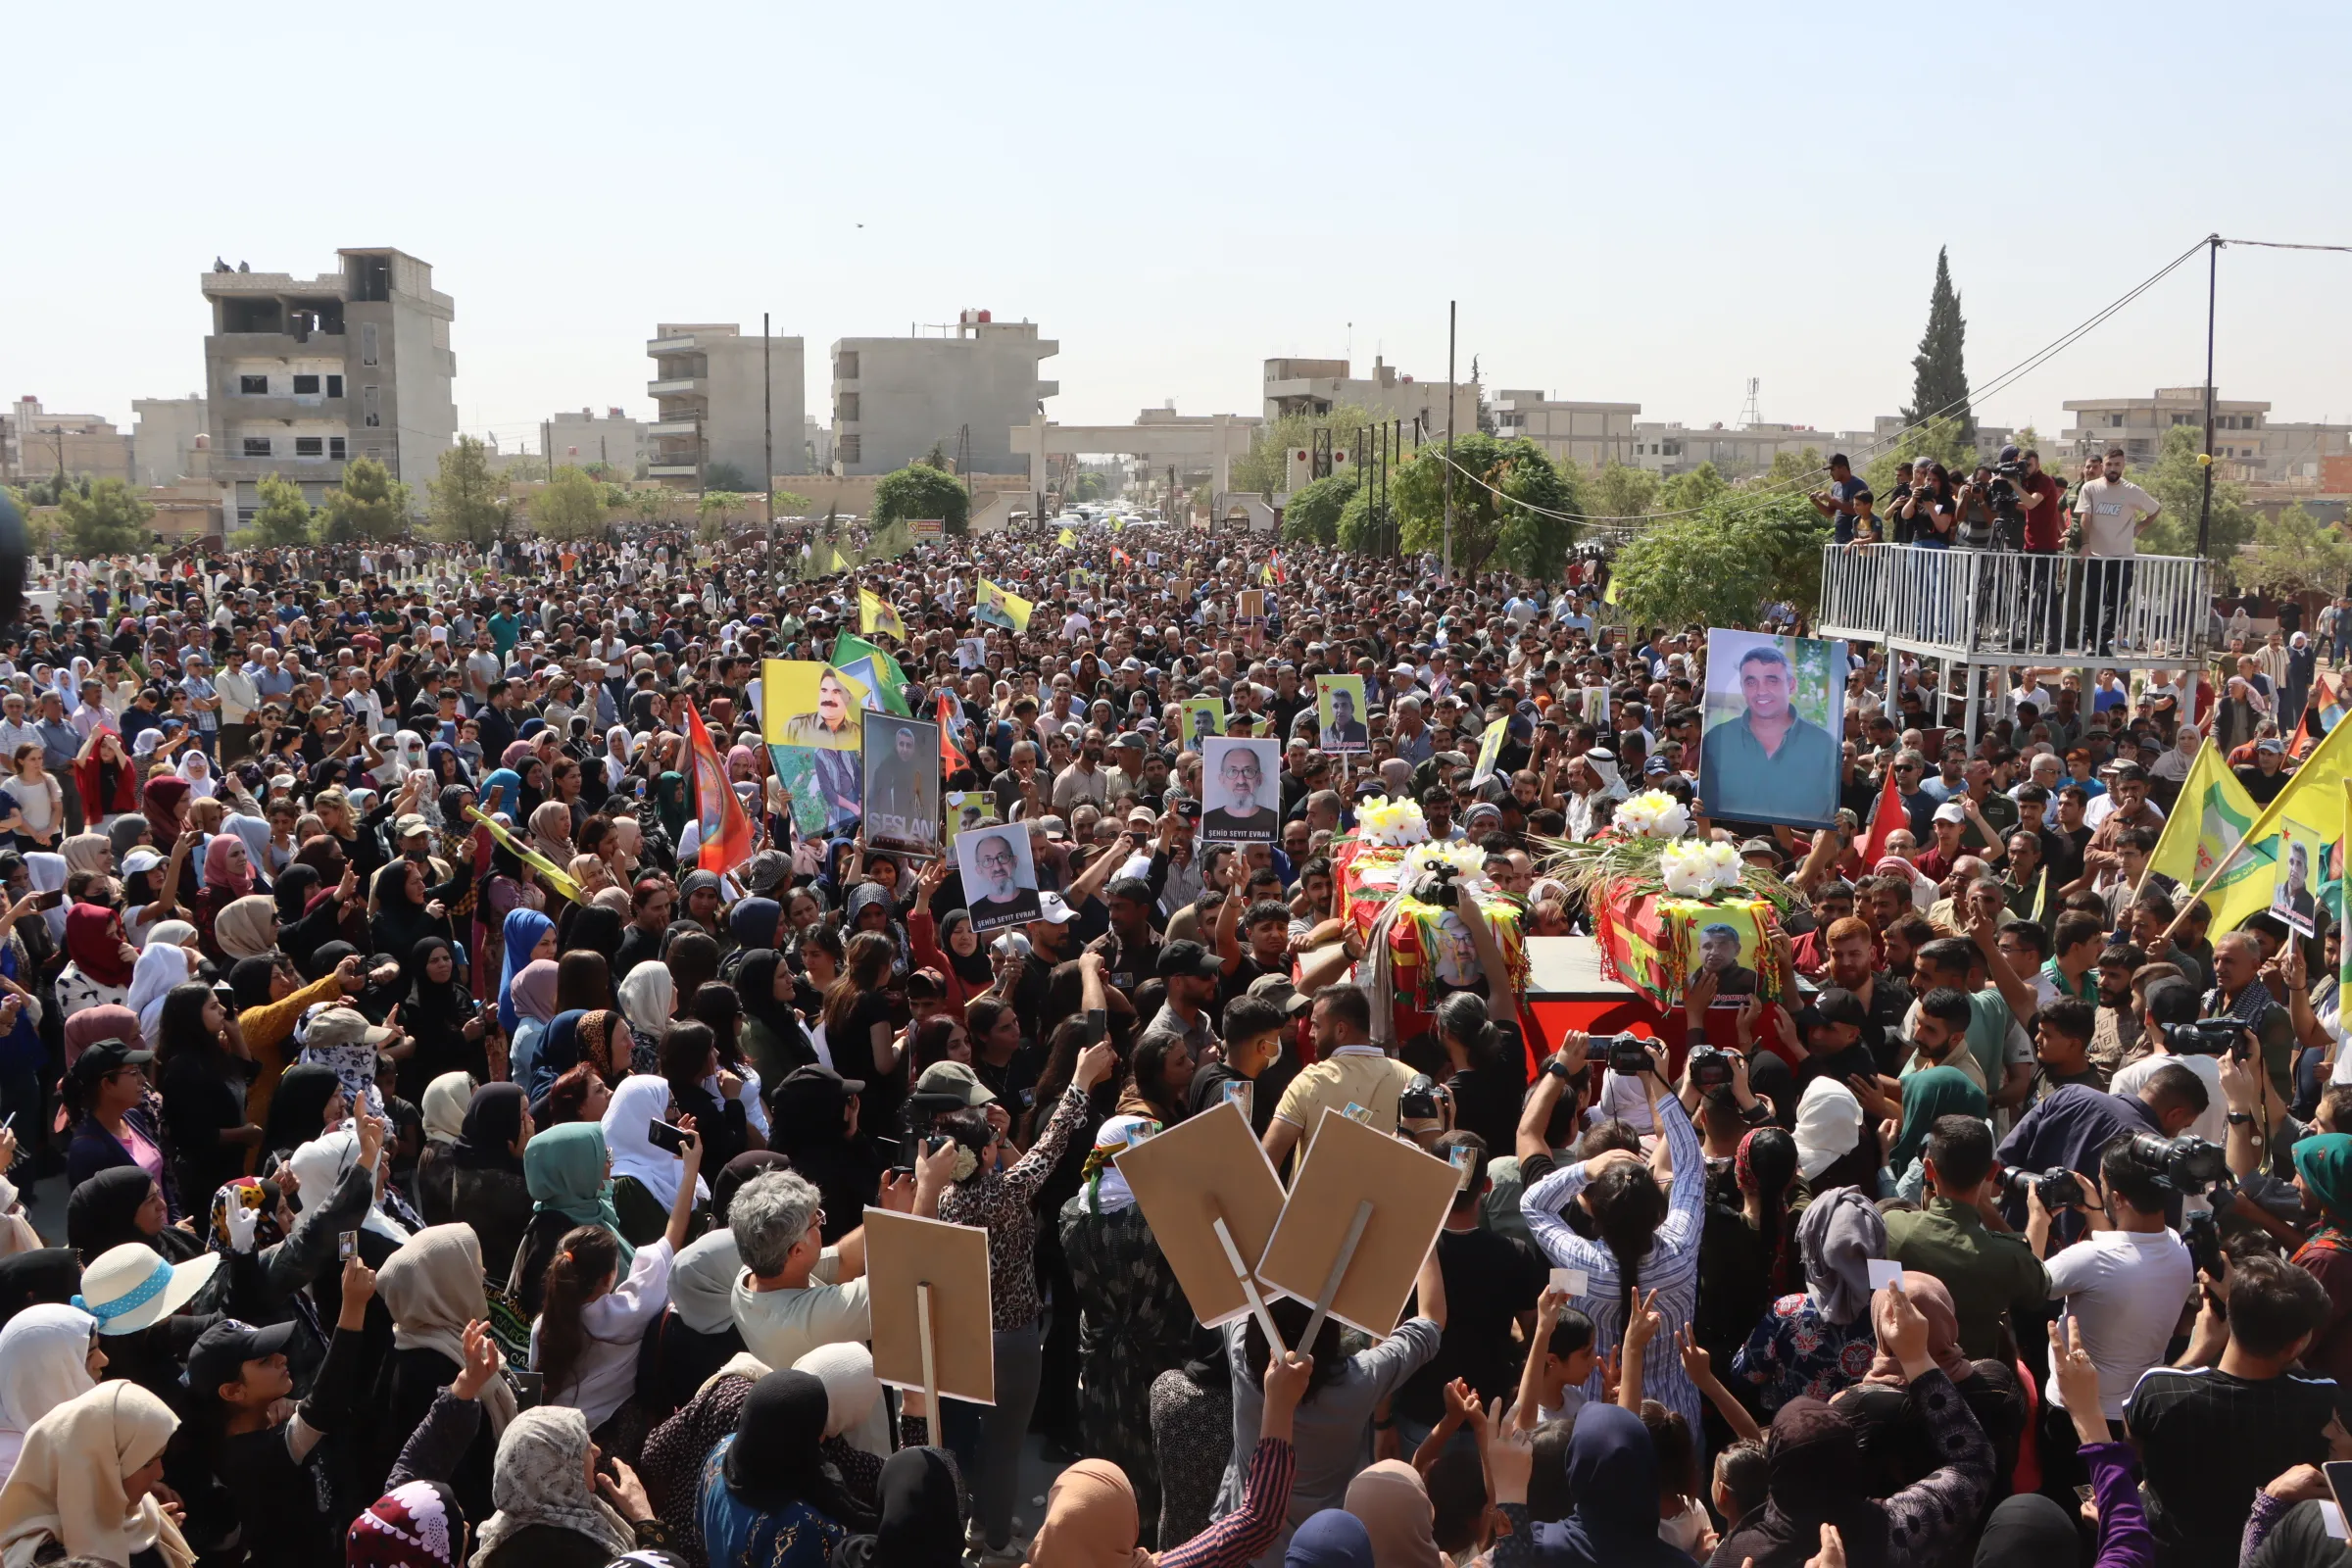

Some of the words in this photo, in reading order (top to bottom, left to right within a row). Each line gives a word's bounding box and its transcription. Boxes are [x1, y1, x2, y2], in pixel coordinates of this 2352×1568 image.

[2095, 502, 2122, 515] NIKE
[1015, 909, 1036, 921] EVRAN
[483, 1286, 527, 1323] ALIFORNIA
